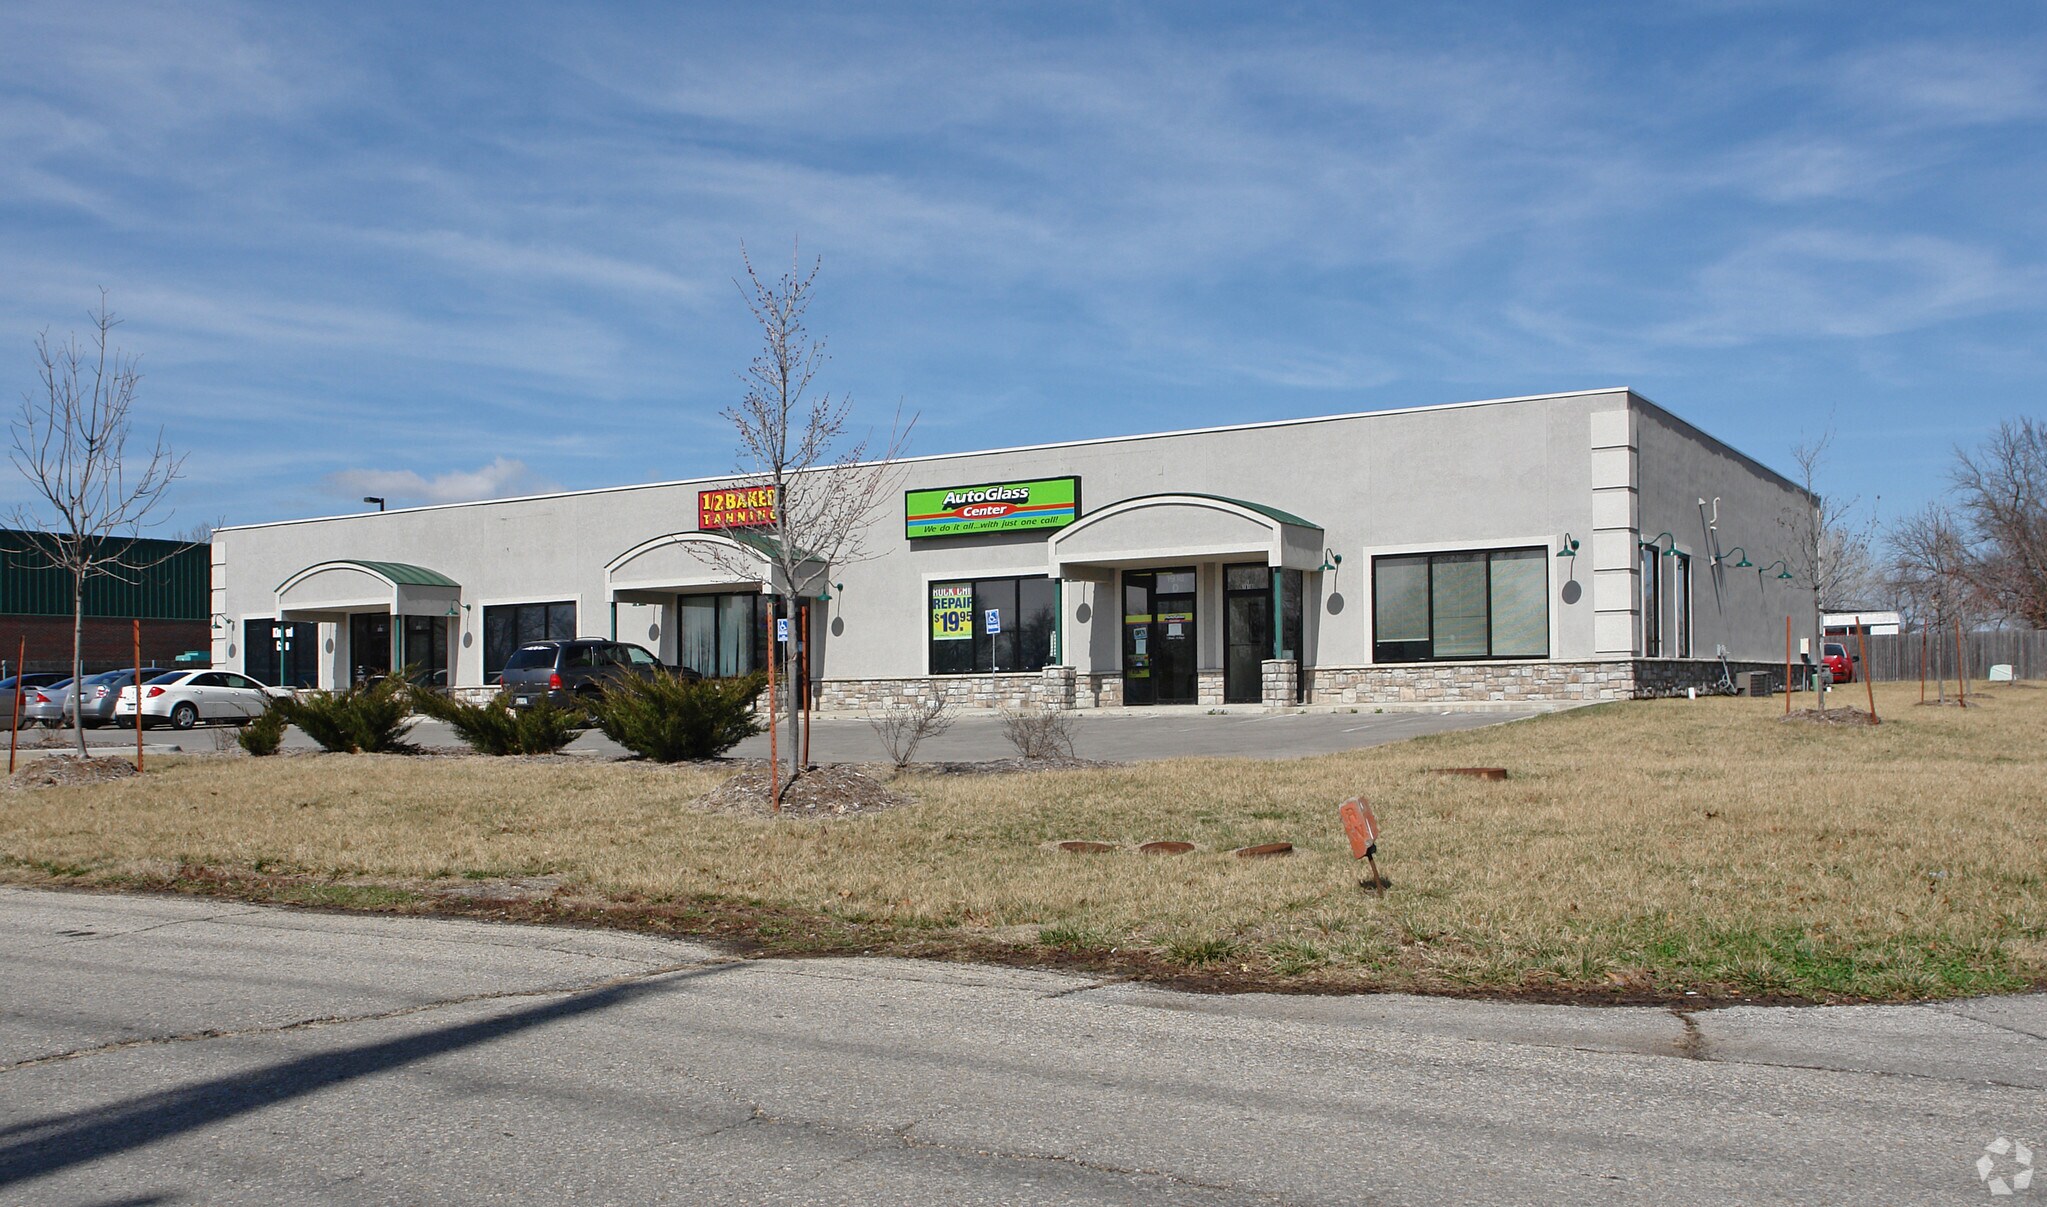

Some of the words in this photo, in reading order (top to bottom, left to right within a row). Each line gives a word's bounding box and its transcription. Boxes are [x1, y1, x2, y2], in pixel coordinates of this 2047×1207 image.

[943, 486, 1029, 505] AutoGlass
[963, 505, 1007, 516] Center
[924, 525, 936, 533] We
[1001, 520, 1017, 528] just
[1040, 516, 1059, 524] call!
